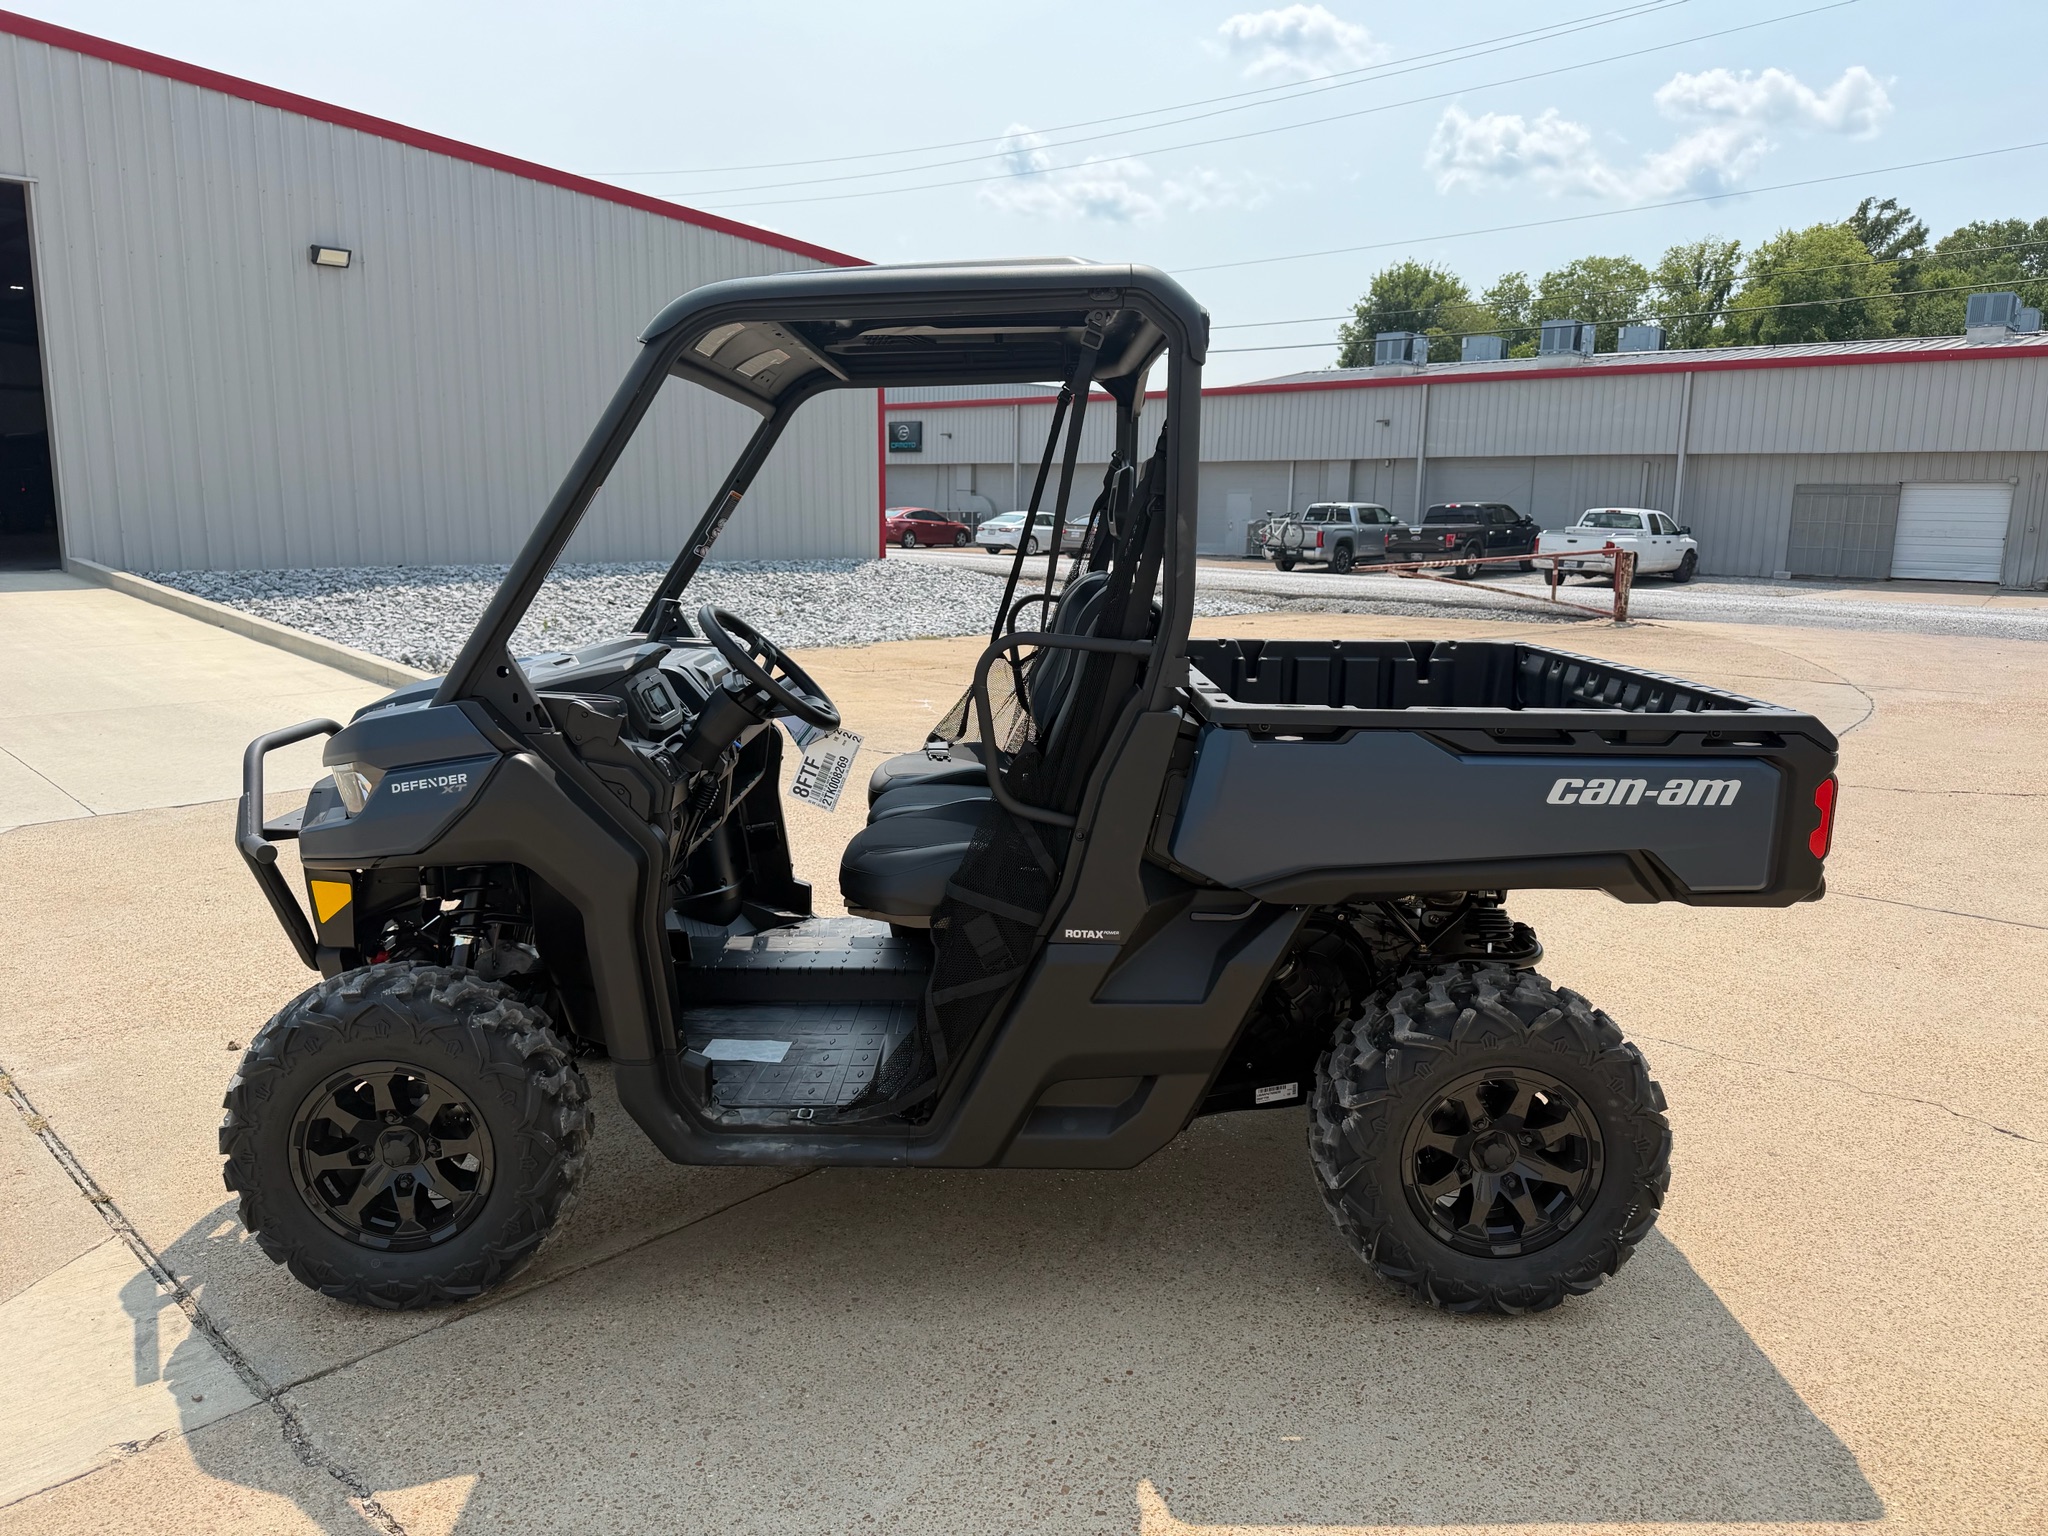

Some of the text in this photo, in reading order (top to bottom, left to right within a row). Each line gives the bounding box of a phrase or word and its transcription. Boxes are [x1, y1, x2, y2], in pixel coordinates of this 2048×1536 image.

[842, 731, 853, 739] 2
[851, 735, 862, 743] 2
[391, 773, 468, 794] DEFENDER
[792, 756, 820, 798] 8FTF
[822, 755, 849, 807] 2TK008269
[441, 783, 468, 795] XT
[1546, 778, 1742, 806] can-am
[1065, 929, 1104, 939] ROTAX
